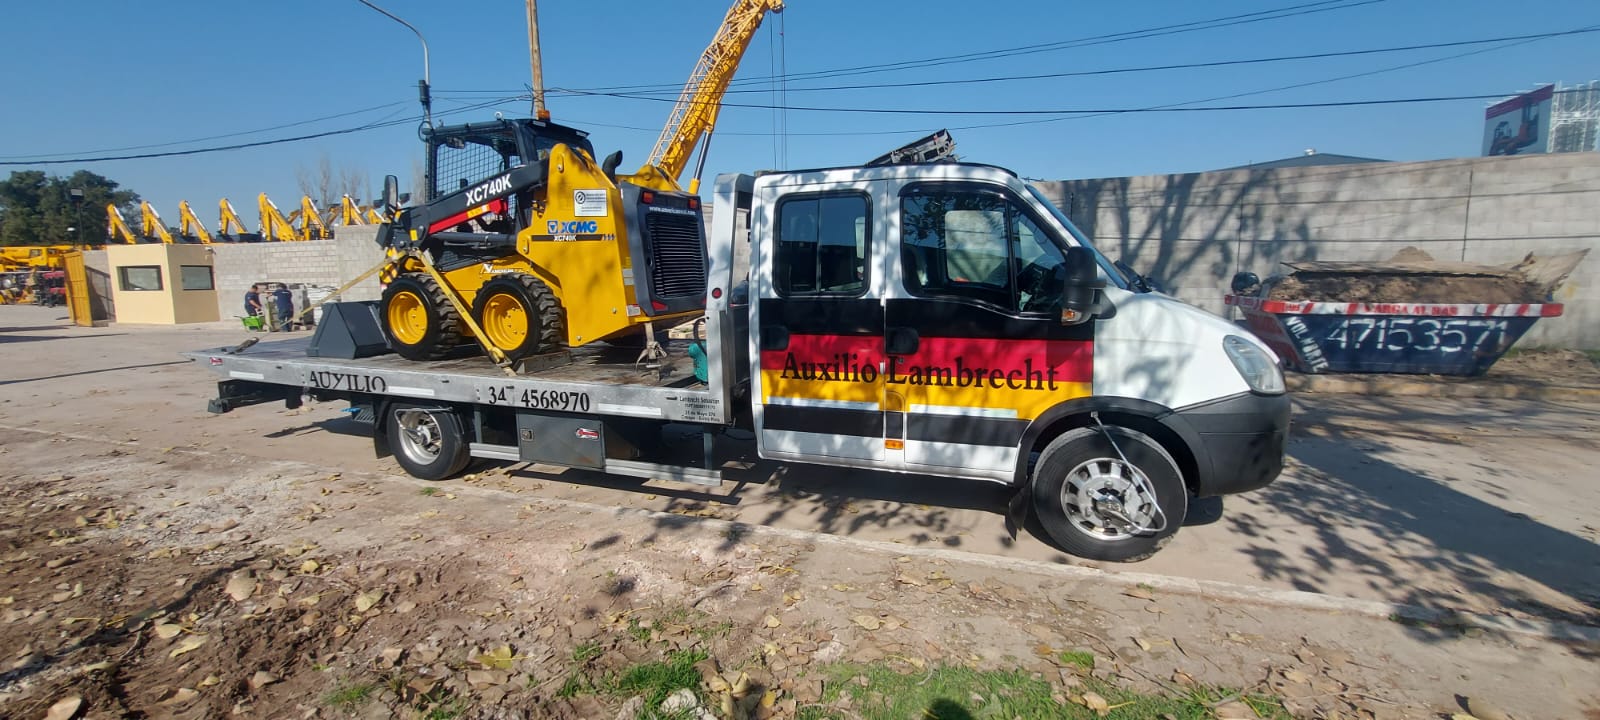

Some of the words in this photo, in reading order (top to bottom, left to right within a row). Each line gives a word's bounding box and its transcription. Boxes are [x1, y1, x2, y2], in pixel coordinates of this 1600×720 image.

[465, 173, 513, 207] XC740K
[560, 220, 597, 233] XCMG
[1327, 317, 1509, 353] 47153571
[780, 352, 877, 383] Auxilio
[886, 355, 1059, 391] Lambrecht
[521, 389, 590, 412] 4568970
